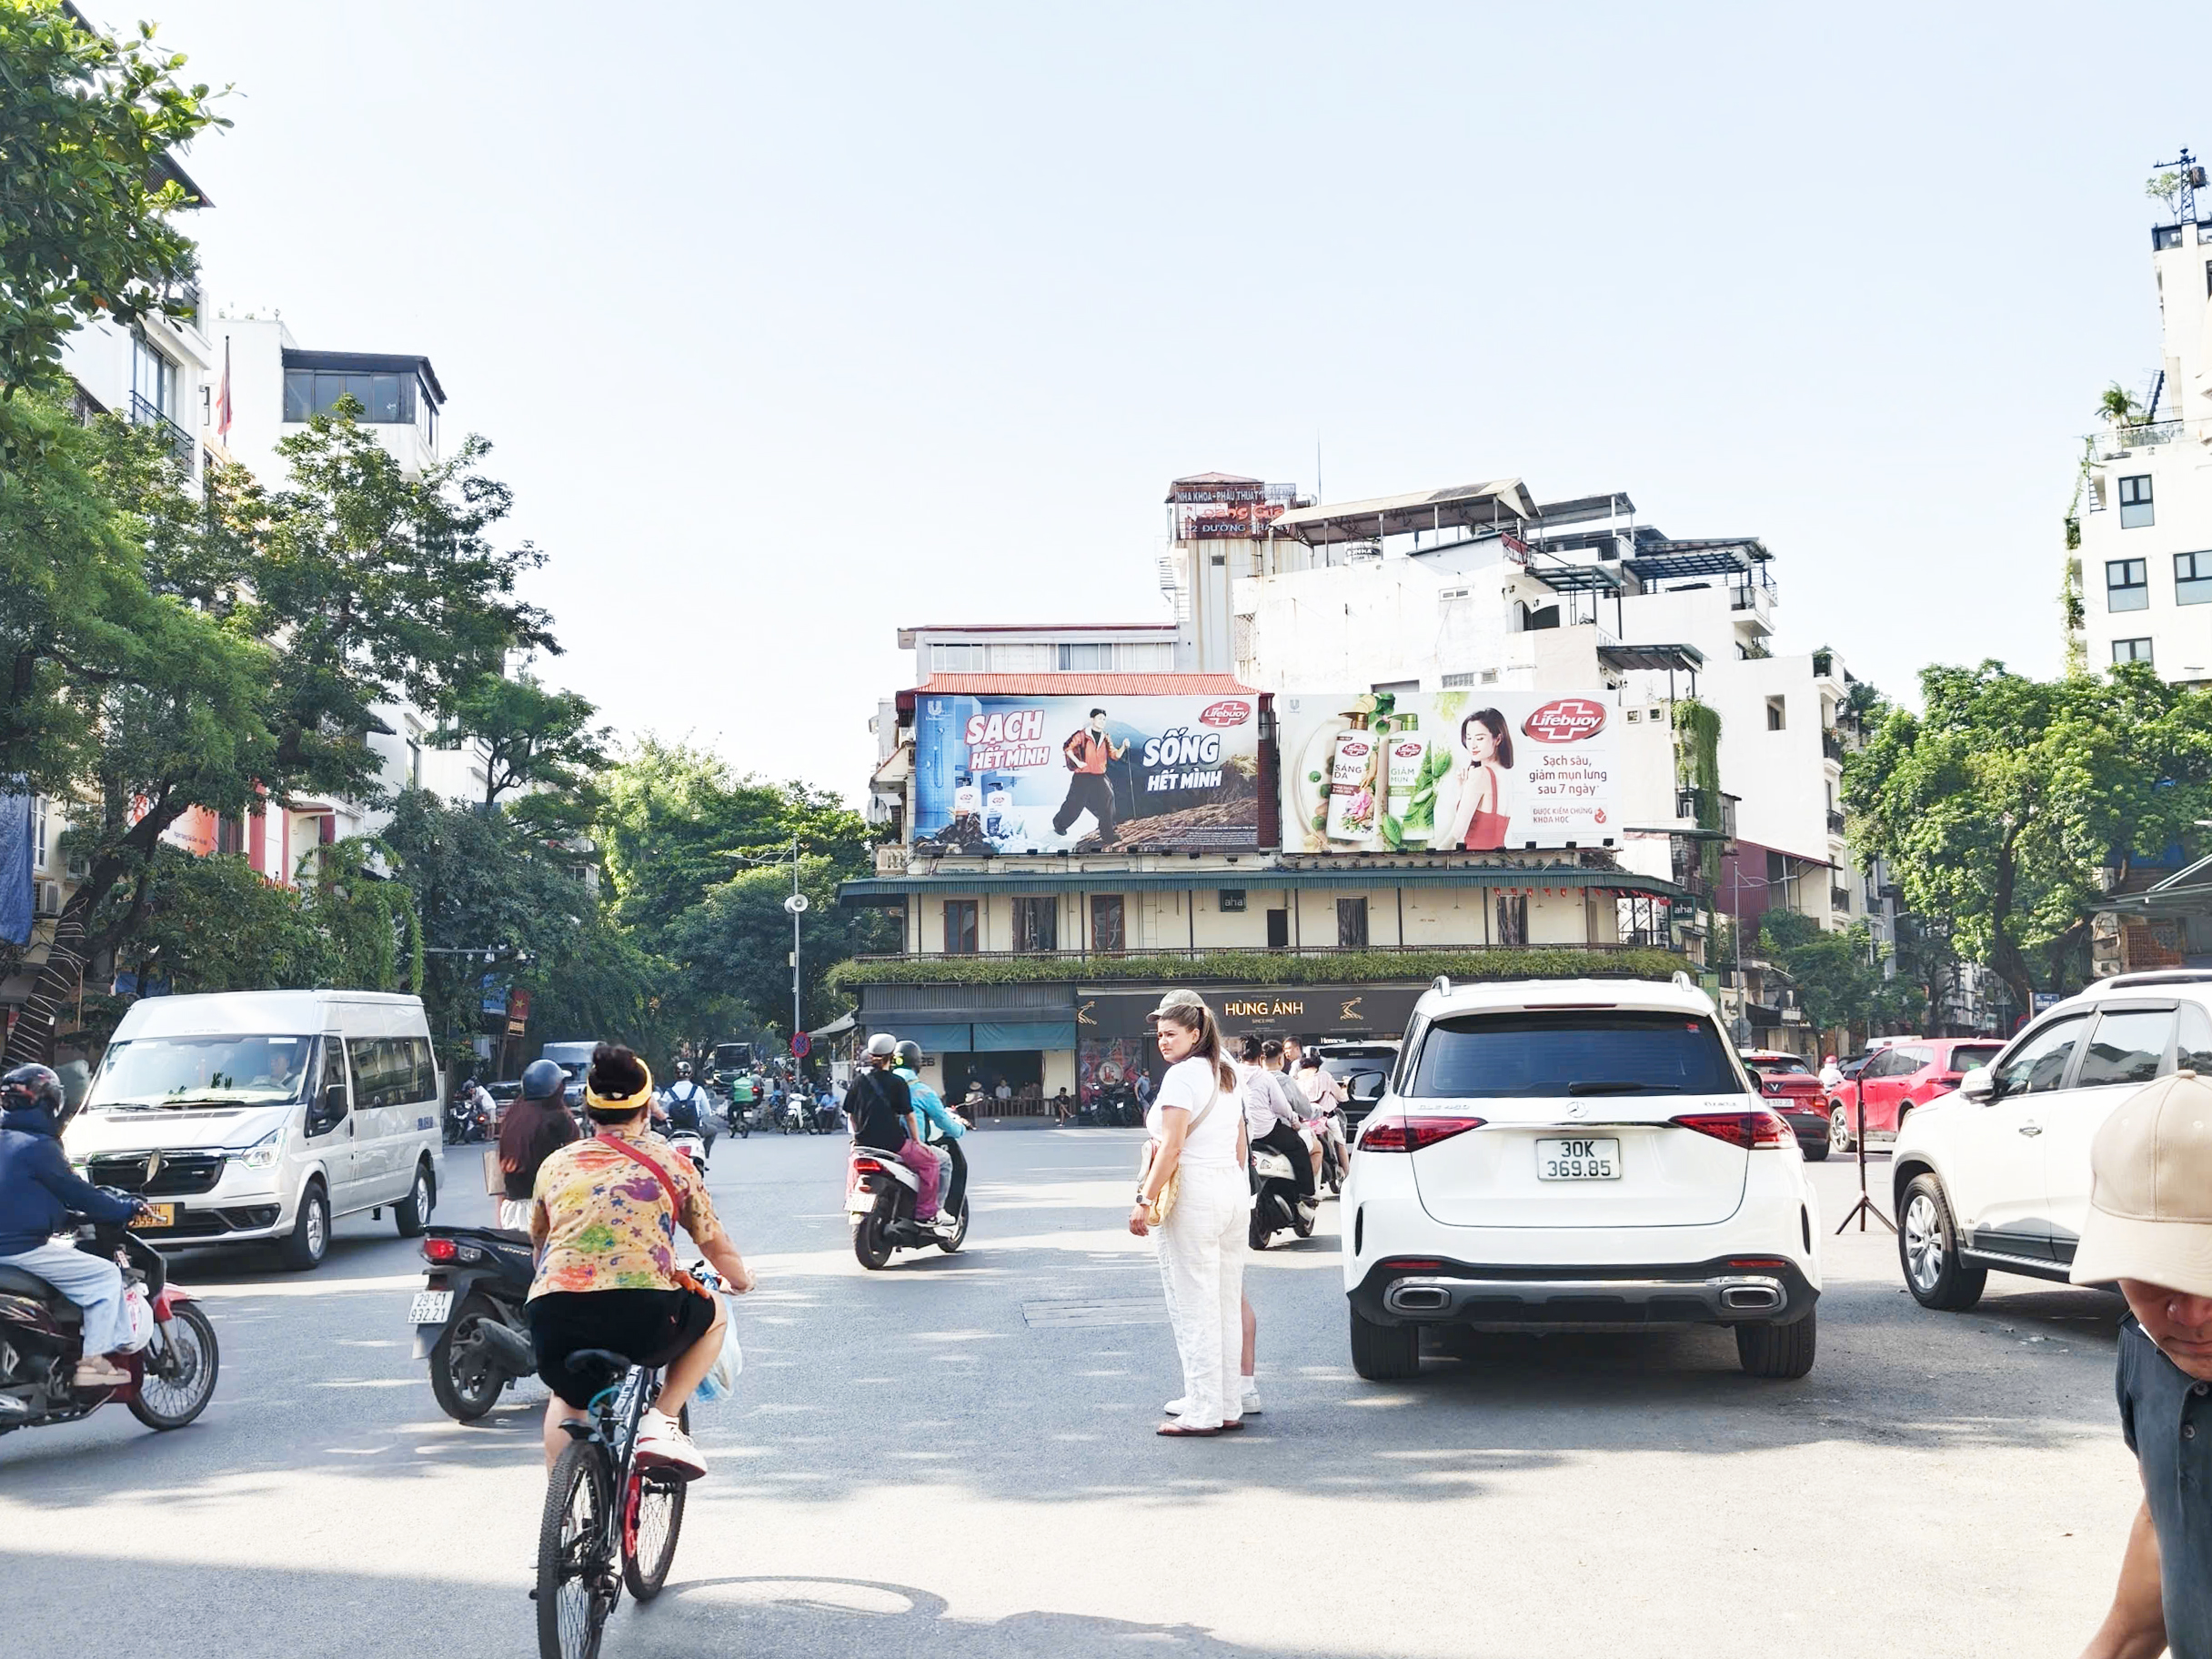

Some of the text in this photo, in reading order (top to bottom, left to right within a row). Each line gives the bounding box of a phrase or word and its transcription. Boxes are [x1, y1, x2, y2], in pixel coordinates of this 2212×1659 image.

[1192, 491, 1212, 501] KHOA
[1204, 709, 1249, 719] Lifebuoy
[1531, 714, 1602, 728] Lifebuoy
[965, 710, 1044, 746] SẠCH
[1142, 727, 1220, 767] SỐNG
[970, 744, 1051, 770] HẾT MÌNH
[1543, 755, 1592, 767] Sạch sâu,
[1147, 767, 1222, 791] HẾT MÌNH
[1334, 771, 1348, 779] DA
[1529, 769, 1607, 782] giảm mụn lưng
[1538, 786, 1557, 794] sau
[1559, 783, 1565, 794] 7
[1554, 816, 1569, 824] HỌC
[1674, 903, 1693, 914] aha
[1224, 998, 1303, 1016] HÙNG ÁNH
[1561, 1141, 1594, 1158] 30K
[1547, 1160, 1611, 1177] 369.85
